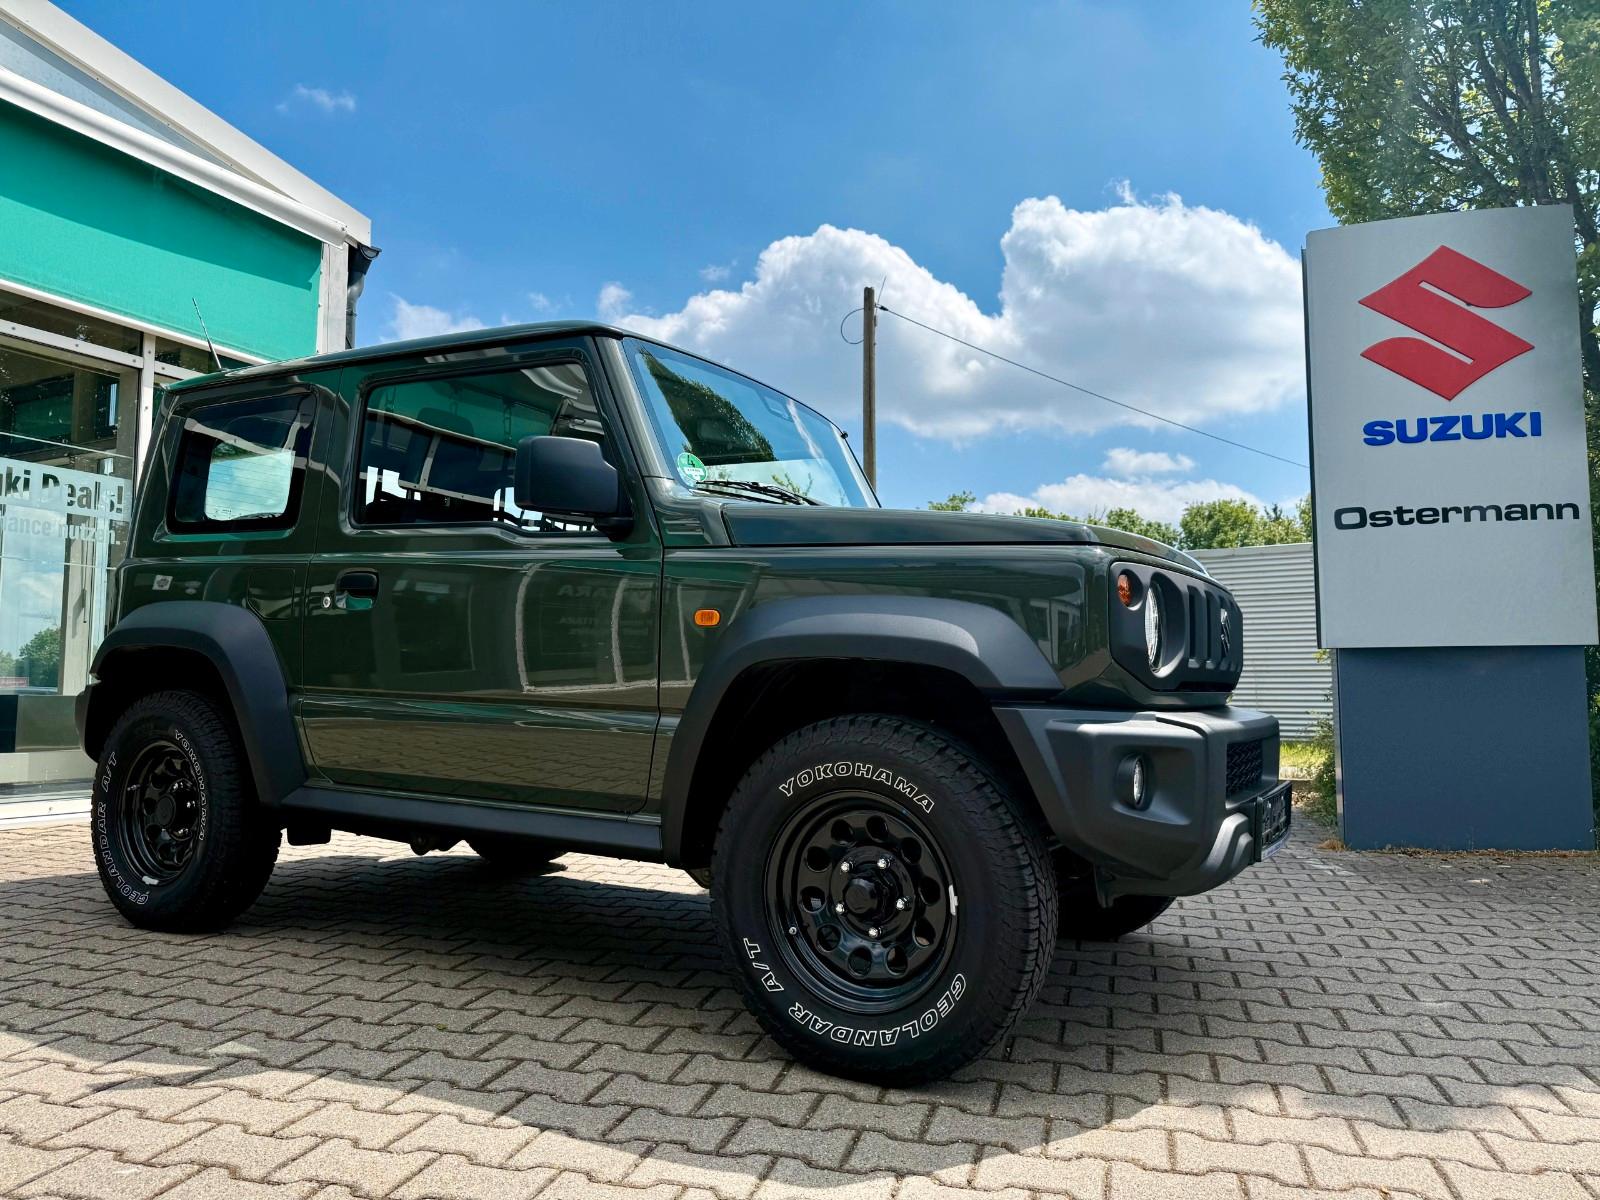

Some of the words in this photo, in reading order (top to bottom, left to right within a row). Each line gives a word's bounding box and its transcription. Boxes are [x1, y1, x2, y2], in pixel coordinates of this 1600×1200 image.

[1363, 412, 1542, 446] SUZUKI
[687, 455, 696, 468] 4
[1334, 502, 1580, 530] Ostermann
[101, 751, 118, 793] A/T
[174, 730, 207, 841] YOKOHAMA
[779, 761, 935, 814] YOKOHAMA
[97, 802, 150, 905] GEOLANDAR
[743, 938, 785, 992] A/T
[788, 973, 967, 1047] GEOLANDAR
